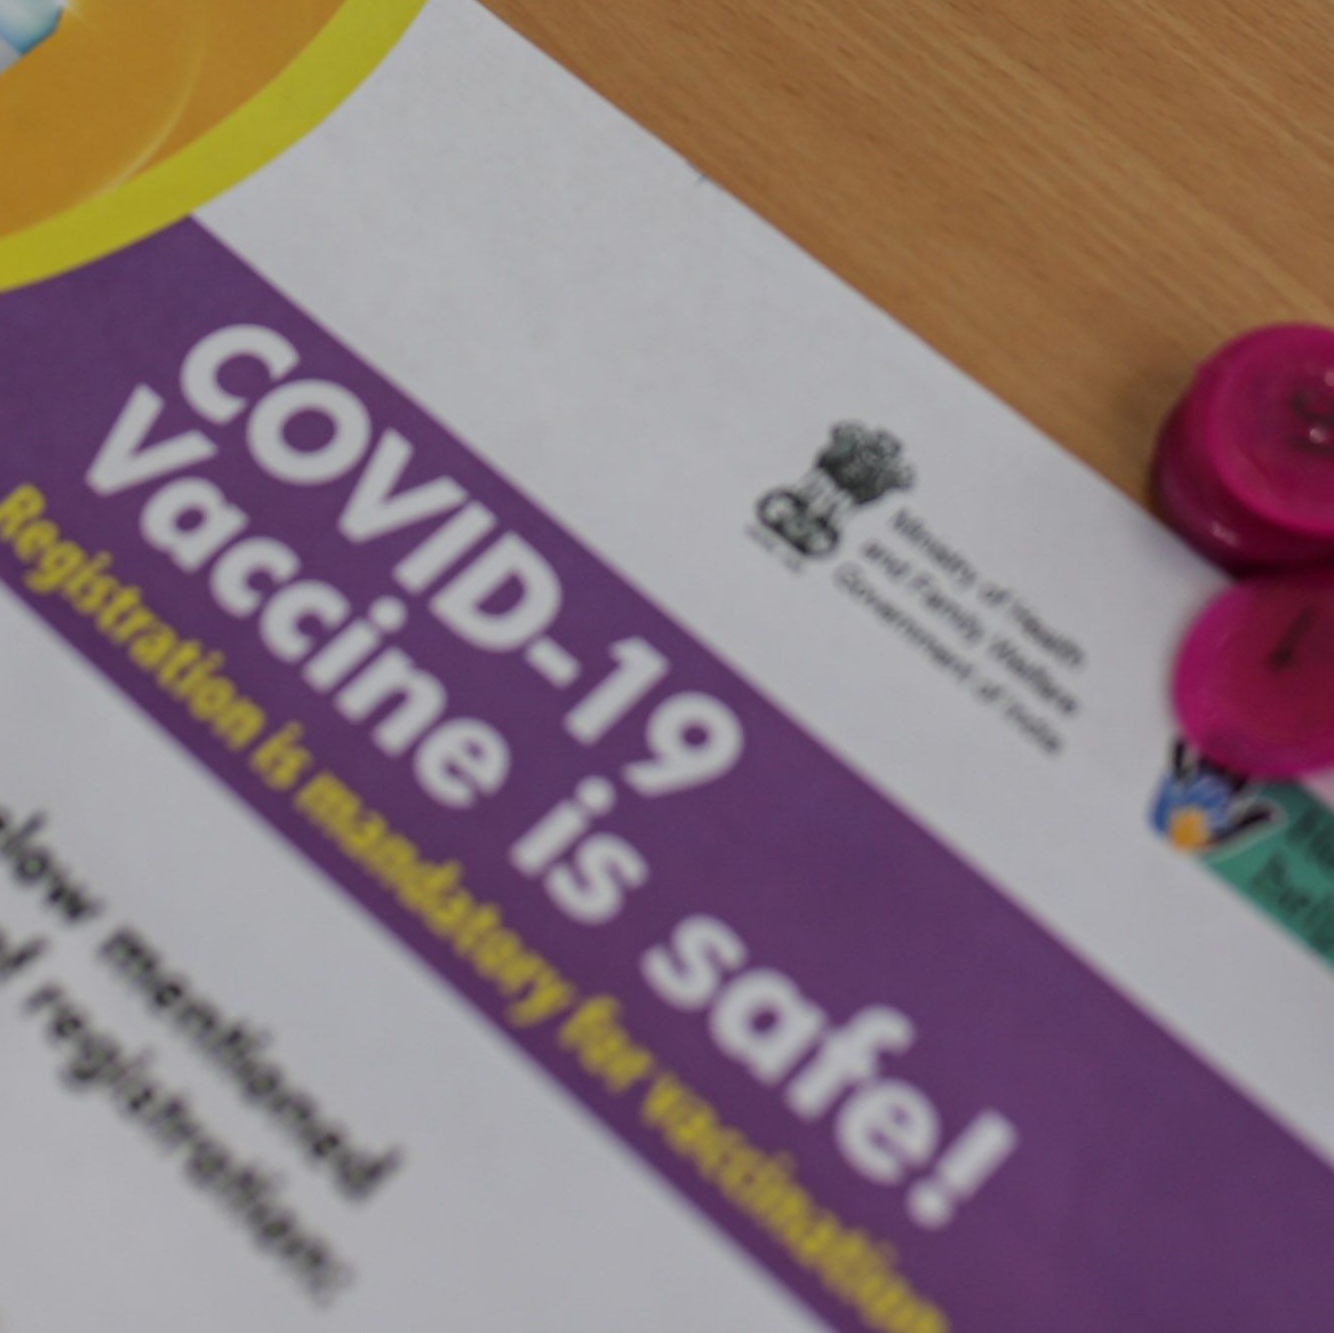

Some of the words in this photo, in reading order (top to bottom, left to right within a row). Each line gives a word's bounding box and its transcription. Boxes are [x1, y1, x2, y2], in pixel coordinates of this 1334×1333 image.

[175, 321, 745, 795] COVID-19
[87, 385, 509, 806] Vaccine
[512, 777, 646, 922] is
[643, 908, 1017, 1222] safe!
[245, 714, 304, 794] is
[297, 760, 572, 1041] mandatory
[563, 984, 653, 1098] for
[99, 928, 398, 1200] mentioned
